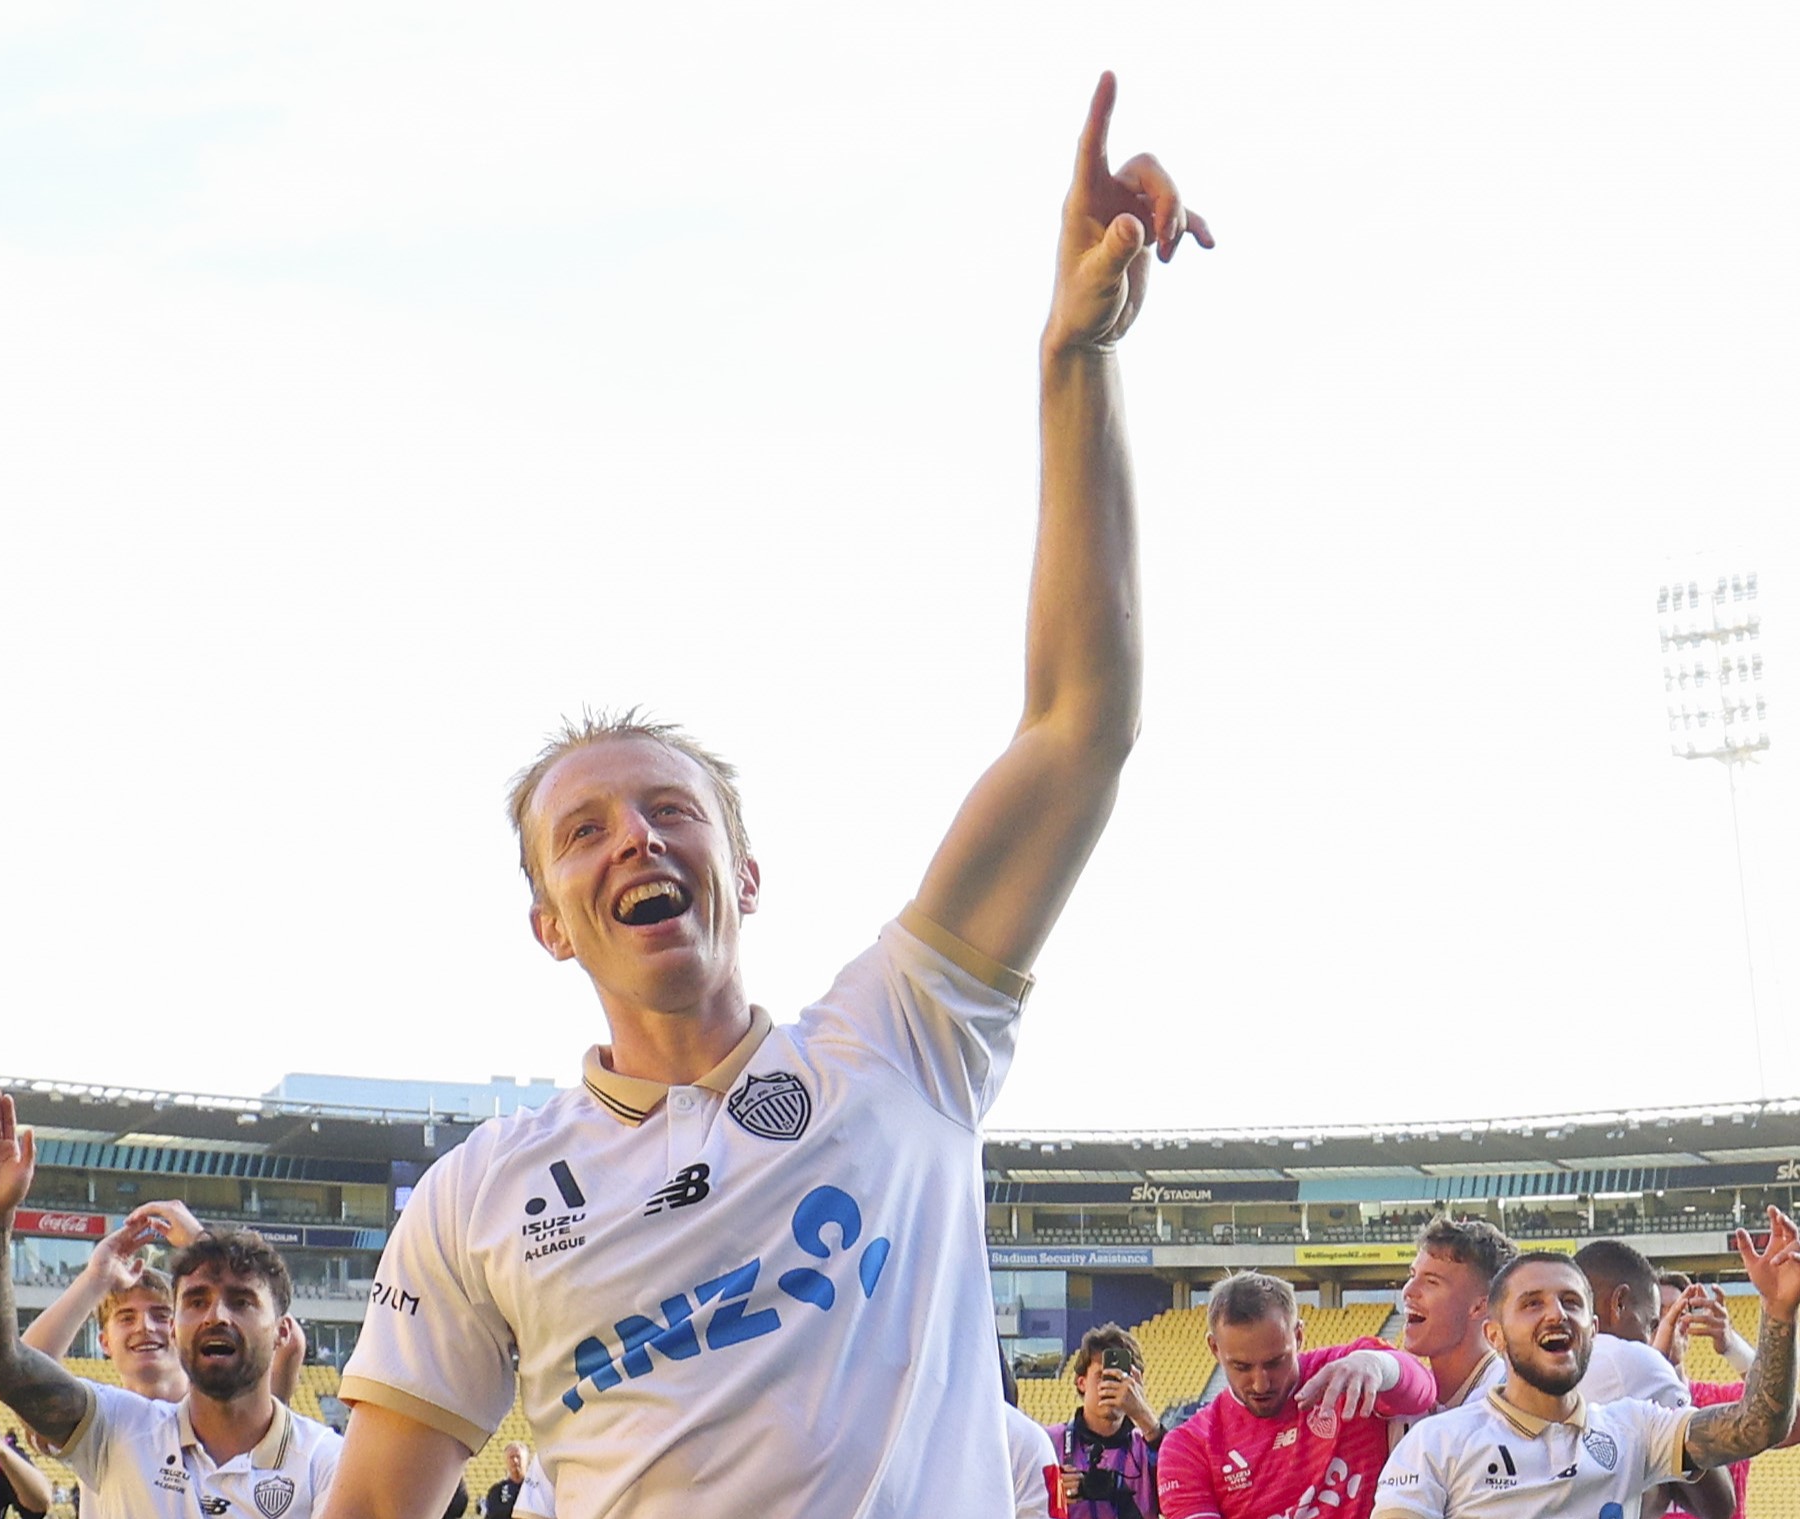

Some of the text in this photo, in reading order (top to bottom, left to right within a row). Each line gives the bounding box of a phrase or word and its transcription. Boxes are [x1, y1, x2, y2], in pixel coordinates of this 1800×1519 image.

[1131, 1182, 1212, 1205] sky STADIUM
[522, 1212, 586, 1236] ISUZU
[535, 1226, 571, 1242] UTE
[524, 1235, 586, 1262] A-LEAGUE
[991, 1252, 1148, 1265] Stadium Security Assistance
[562, 1256, 782, 1414] ANZ
